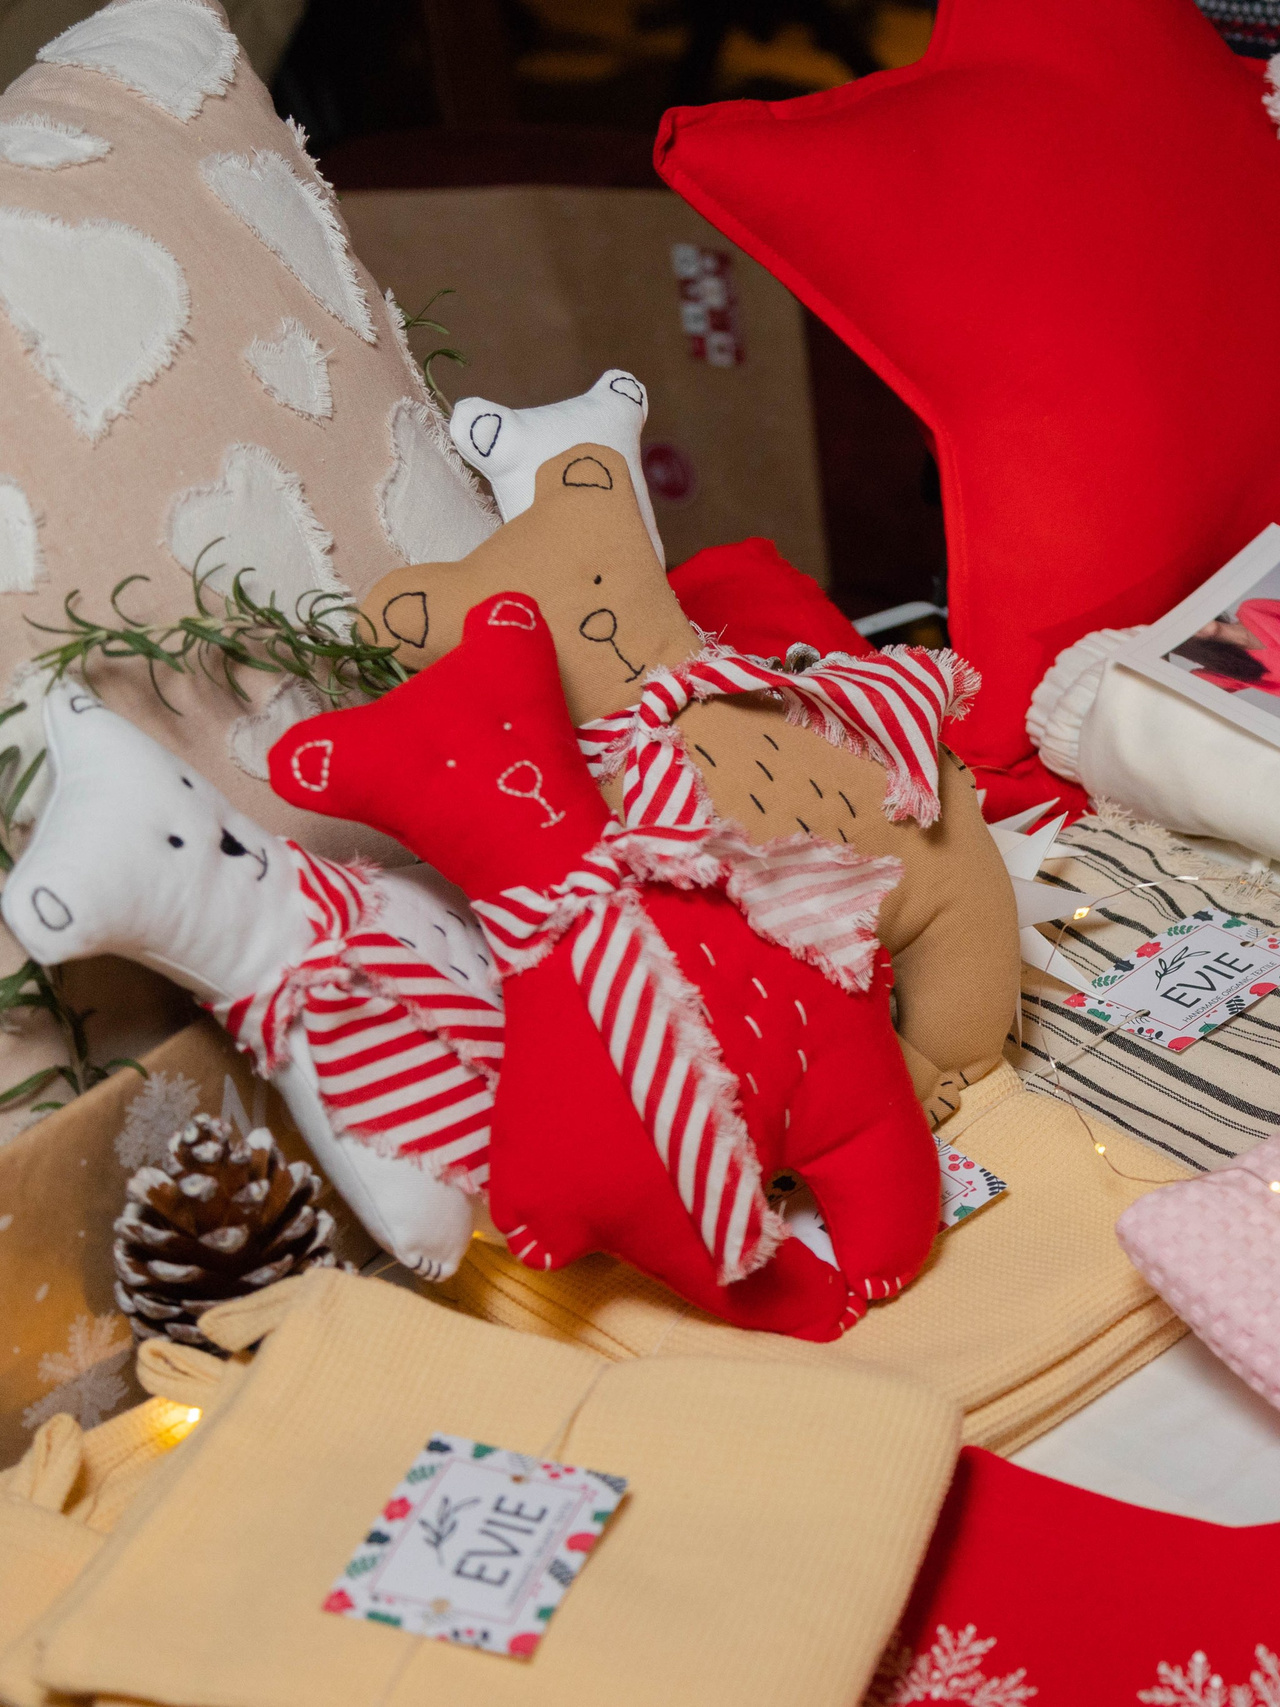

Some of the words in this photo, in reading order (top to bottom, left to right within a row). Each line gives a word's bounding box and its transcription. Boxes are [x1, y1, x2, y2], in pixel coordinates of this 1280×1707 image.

[1160, 951, 1254, 1008] EVIE
[1182, 995, 1223, 1023] HANDMADE
[1221, 976, 1253, 997] ORGANIC
[1251, 961, 1277, 977] TEXTILE
[454, 1495, 548, 1587] EVIE
